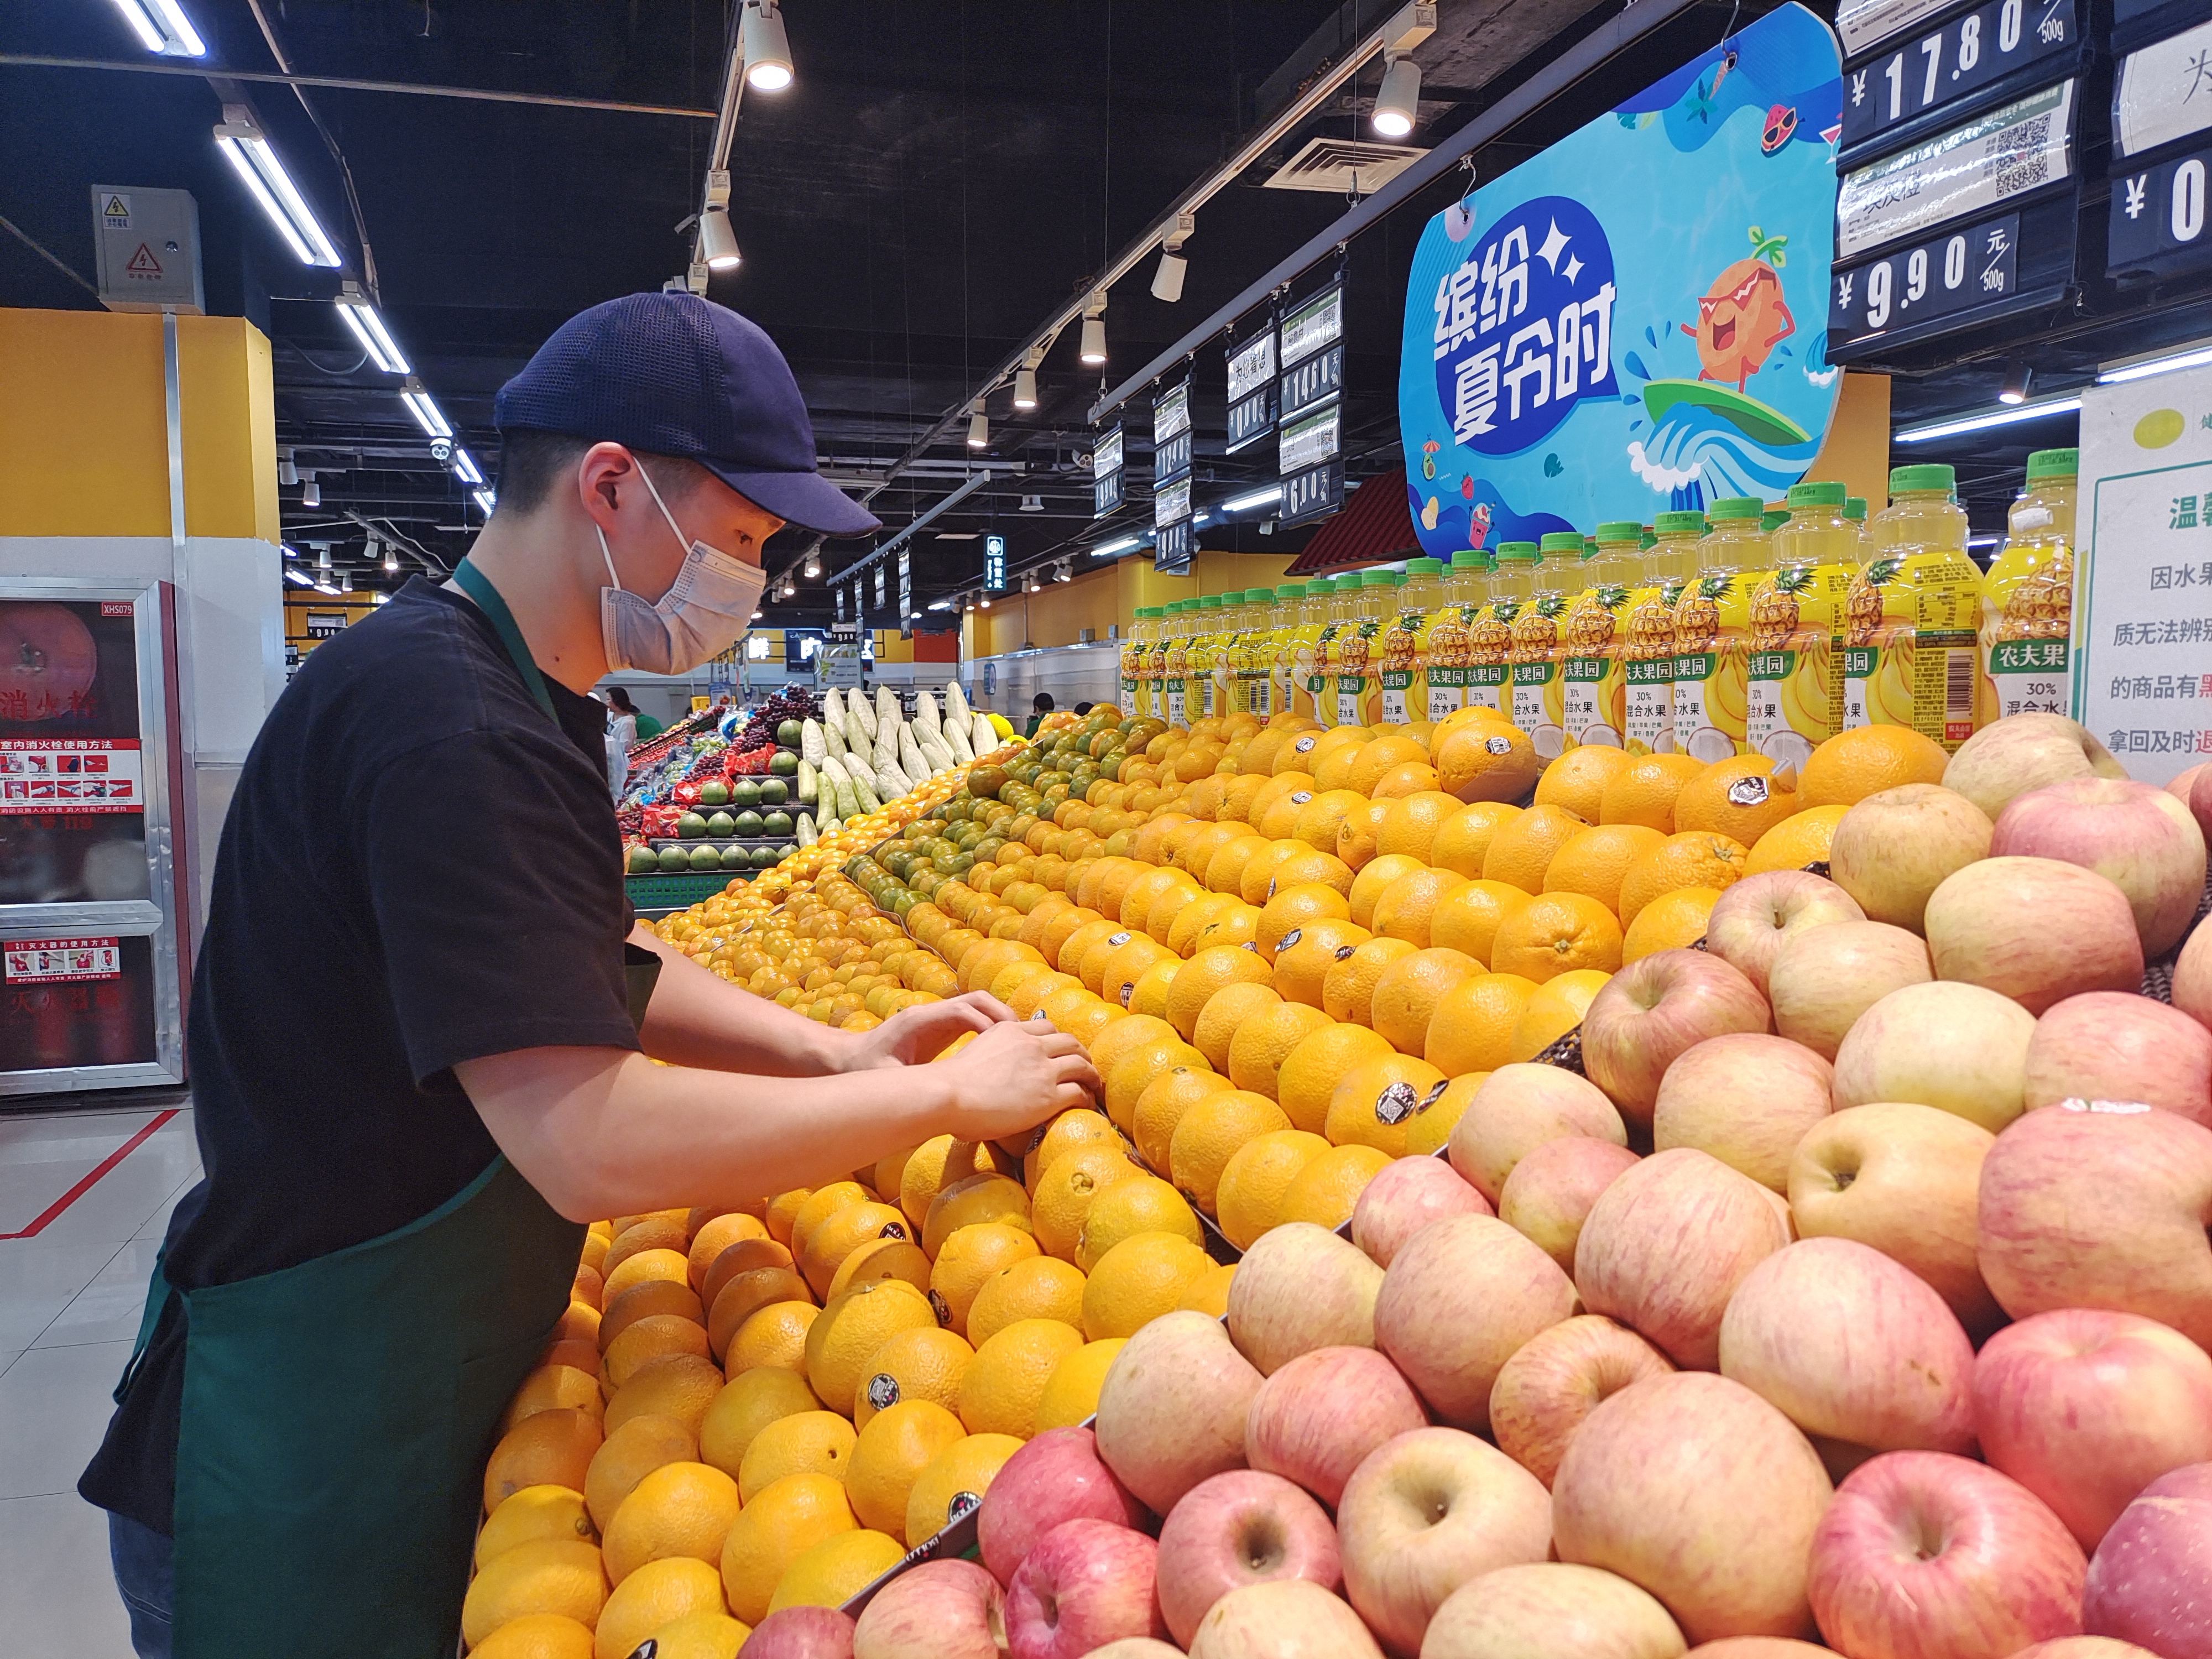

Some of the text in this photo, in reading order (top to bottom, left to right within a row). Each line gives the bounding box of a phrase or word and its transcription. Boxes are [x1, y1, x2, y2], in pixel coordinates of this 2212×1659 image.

[1434, 225, 1529, 362] 缤纷
[104, 605, 132, 614] XHS079
[1675, 688, 1687, 698] 0%
[2026, 683, 2057, 695] 30%
[1516, 692, 1528, 701] 30%
[1636, 692, 1652, 701] 30%
[0, 690, 98, 719] 消火栓
[0, 740, 113, 750] 室内消火栓使用方法
[29, 939, 109, 950] 灭火器的使用方法
